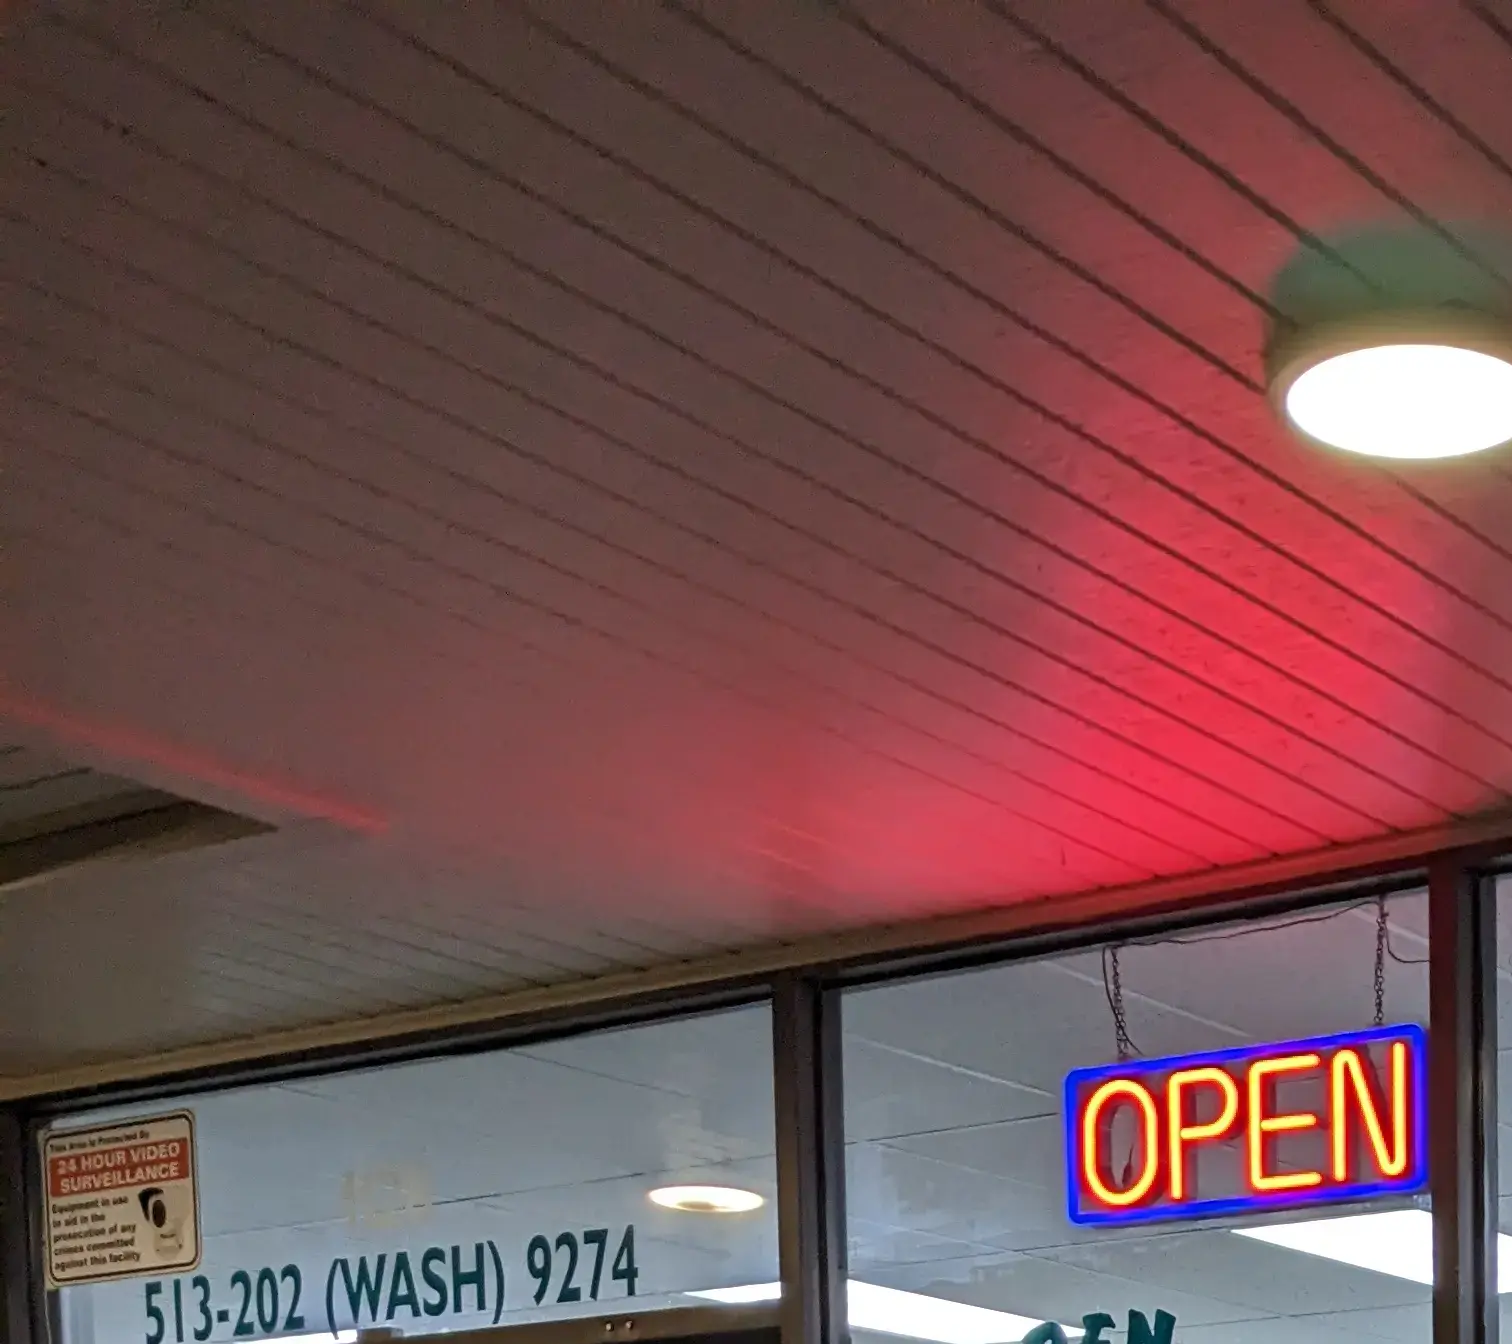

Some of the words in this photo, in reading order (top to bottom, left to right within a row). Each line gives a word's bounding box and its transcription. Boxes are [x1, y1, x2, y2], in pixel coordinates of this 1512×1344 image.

[57, 1160, 77, 1175] 24
[81, 1151, 126, 1171] HOUR
[130, 1142, 180, 1160] VIDEO
[1080, 1038, 1411, 1207] OPEN
[60, 1161, 180, 1194] SURVEILLANCE
[326, 1240, 504, 1340] (WASH)
[527, 1224, 639, 1306] 9274
